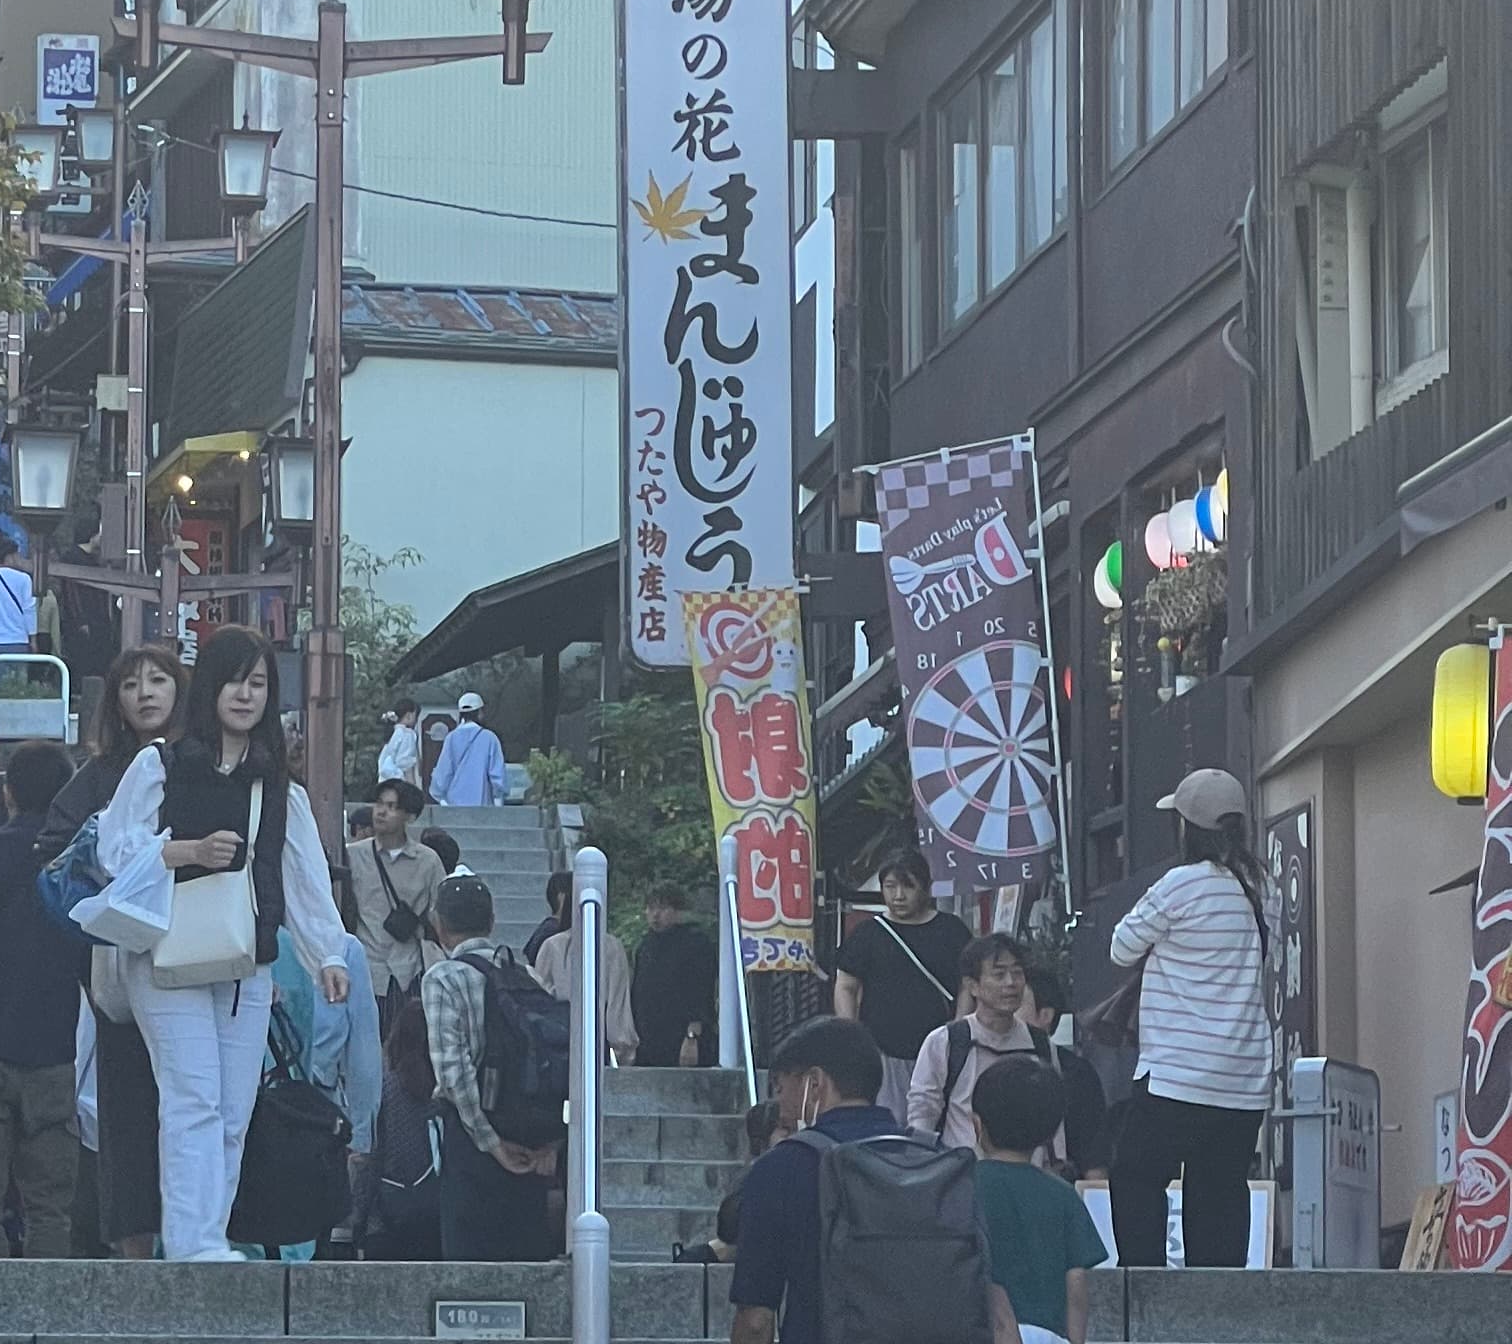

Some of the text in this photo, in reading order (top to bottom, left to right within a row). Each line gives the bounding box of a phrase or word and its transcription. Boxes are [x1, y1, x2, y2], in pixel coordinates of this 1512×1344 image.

[635, 406, 668, 644] つたや物産店
